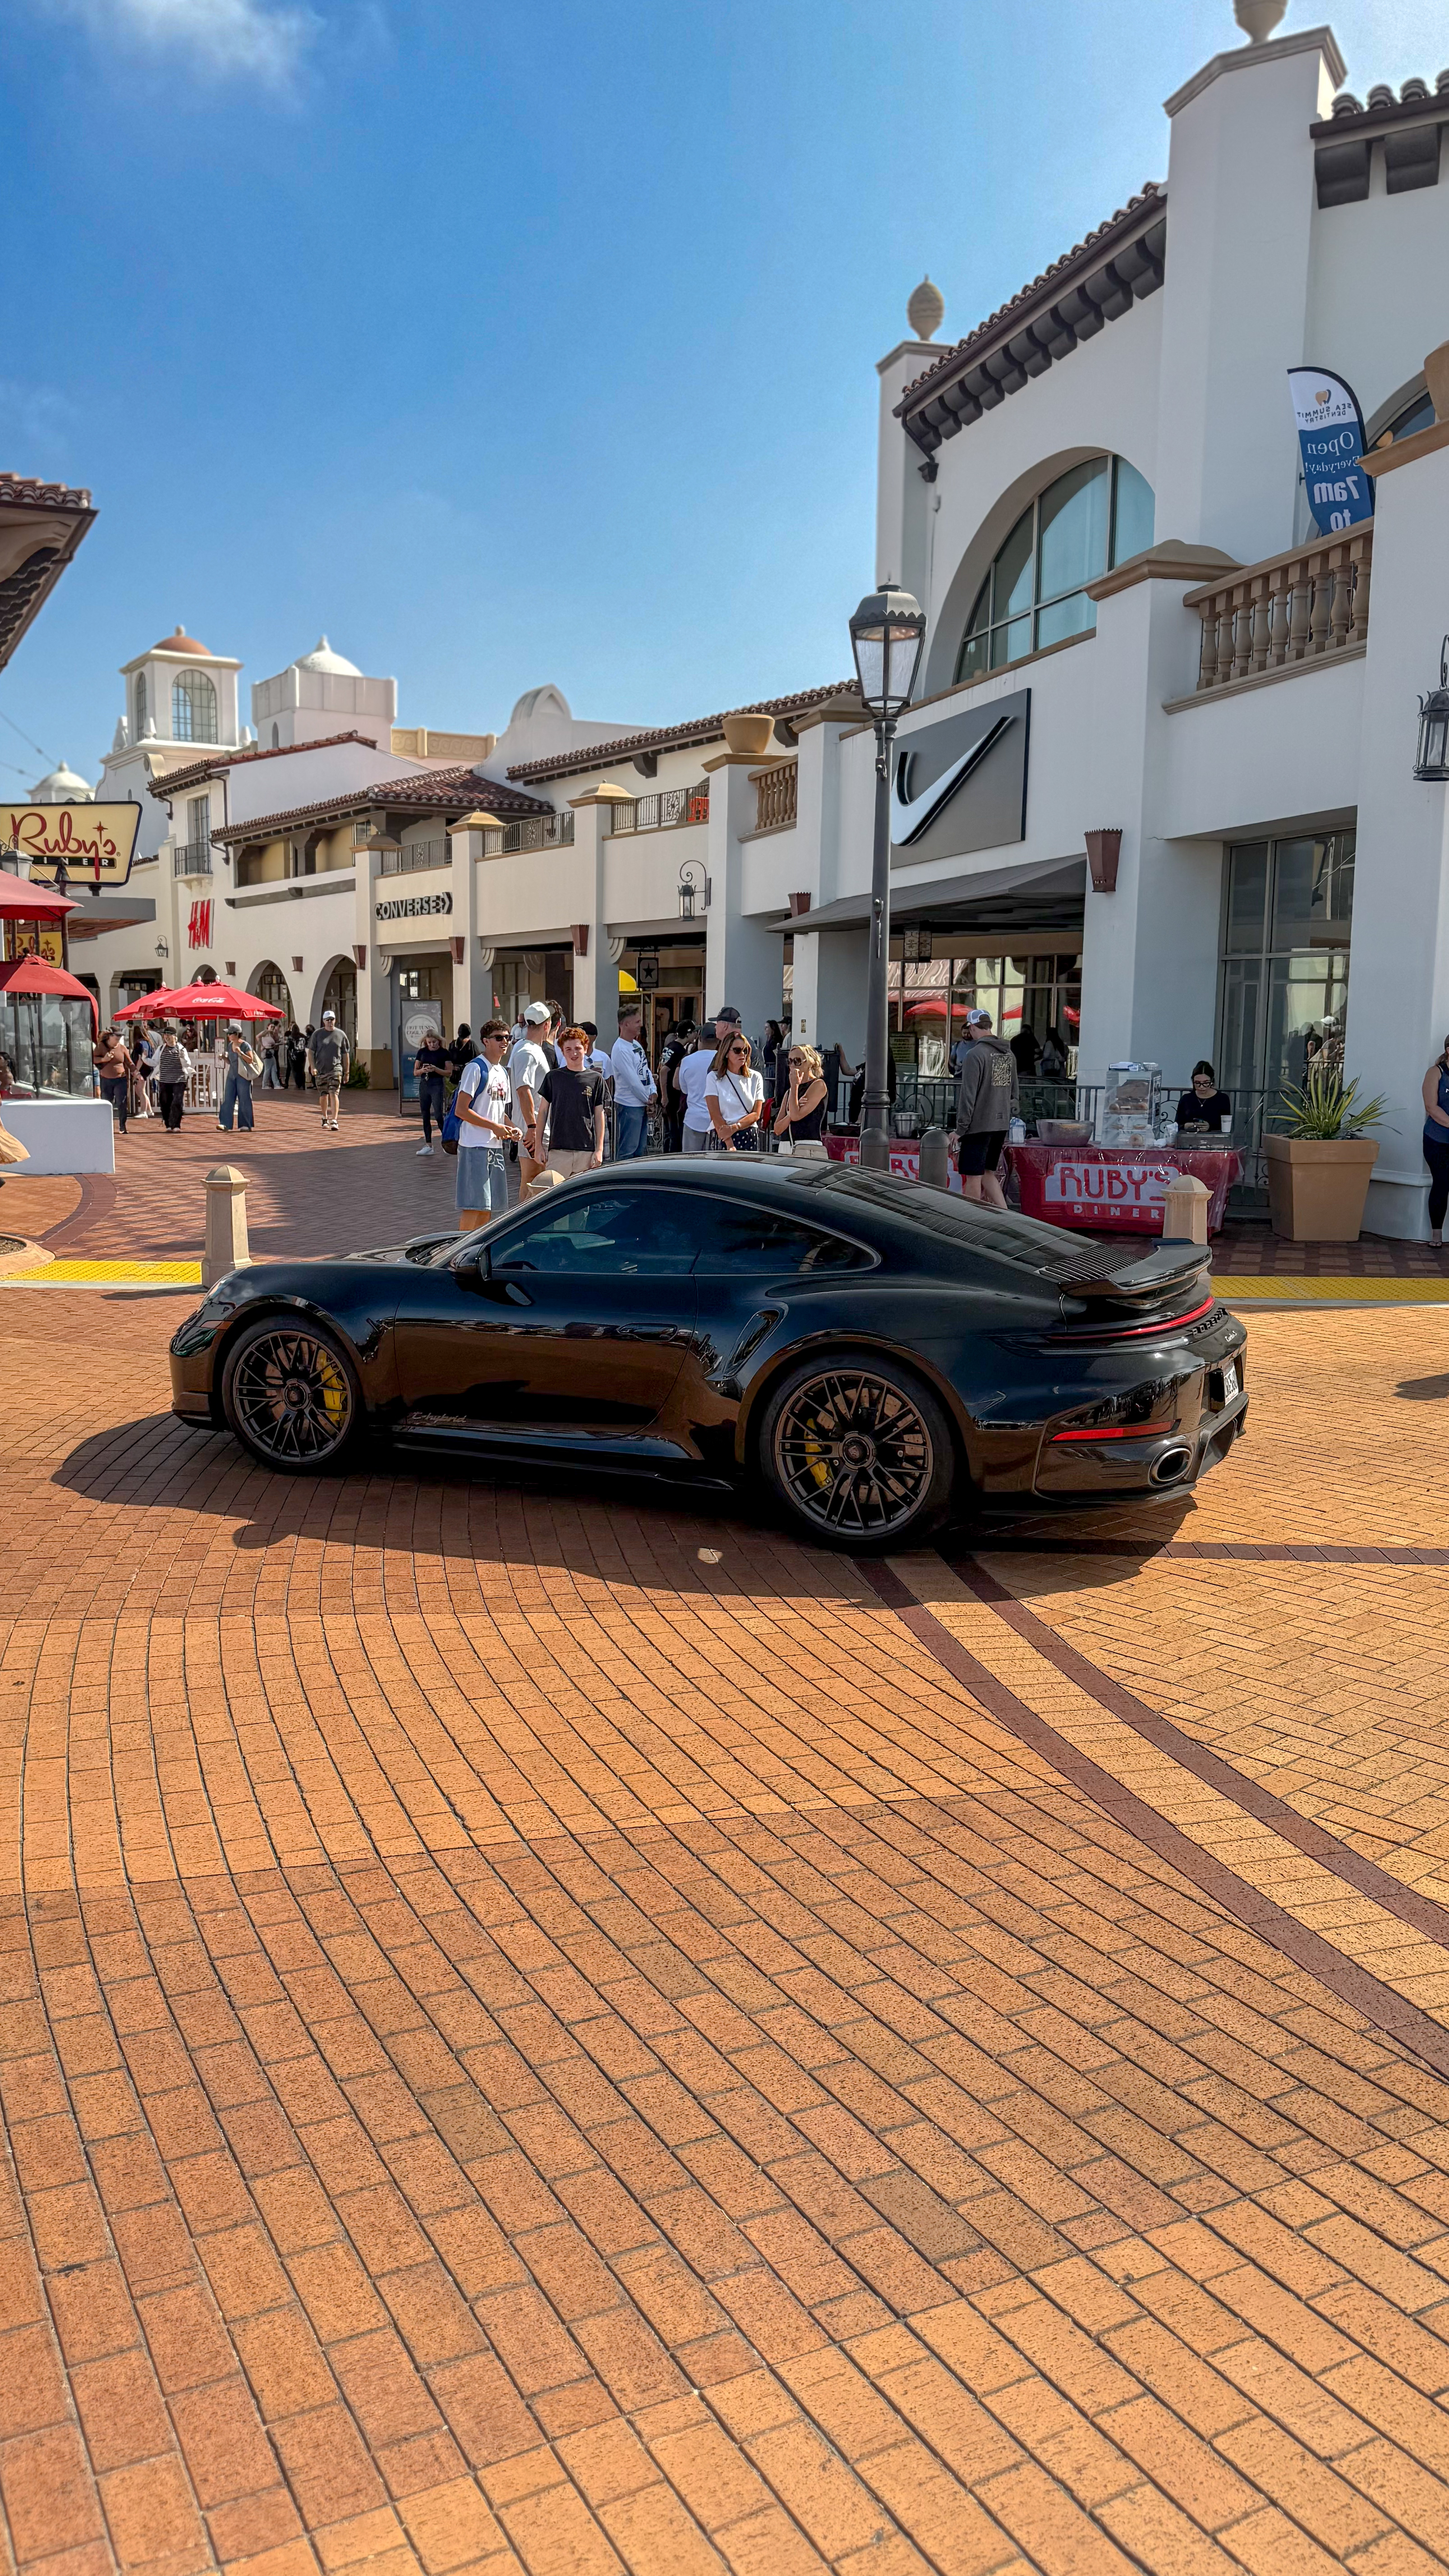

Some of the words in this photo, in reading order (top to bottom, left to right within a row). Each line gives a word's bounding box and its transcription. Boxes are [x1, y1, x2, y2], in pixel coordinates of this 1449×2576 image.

[10, 811, 116, 881] Ruby's
[43, 857, 109, 867] INER
[374, 895, 438, 920] CONVERSE
[1060, 1167, 1171, 1201] RUBY'S
[1073, 1205, 1160, 1219] DINER
